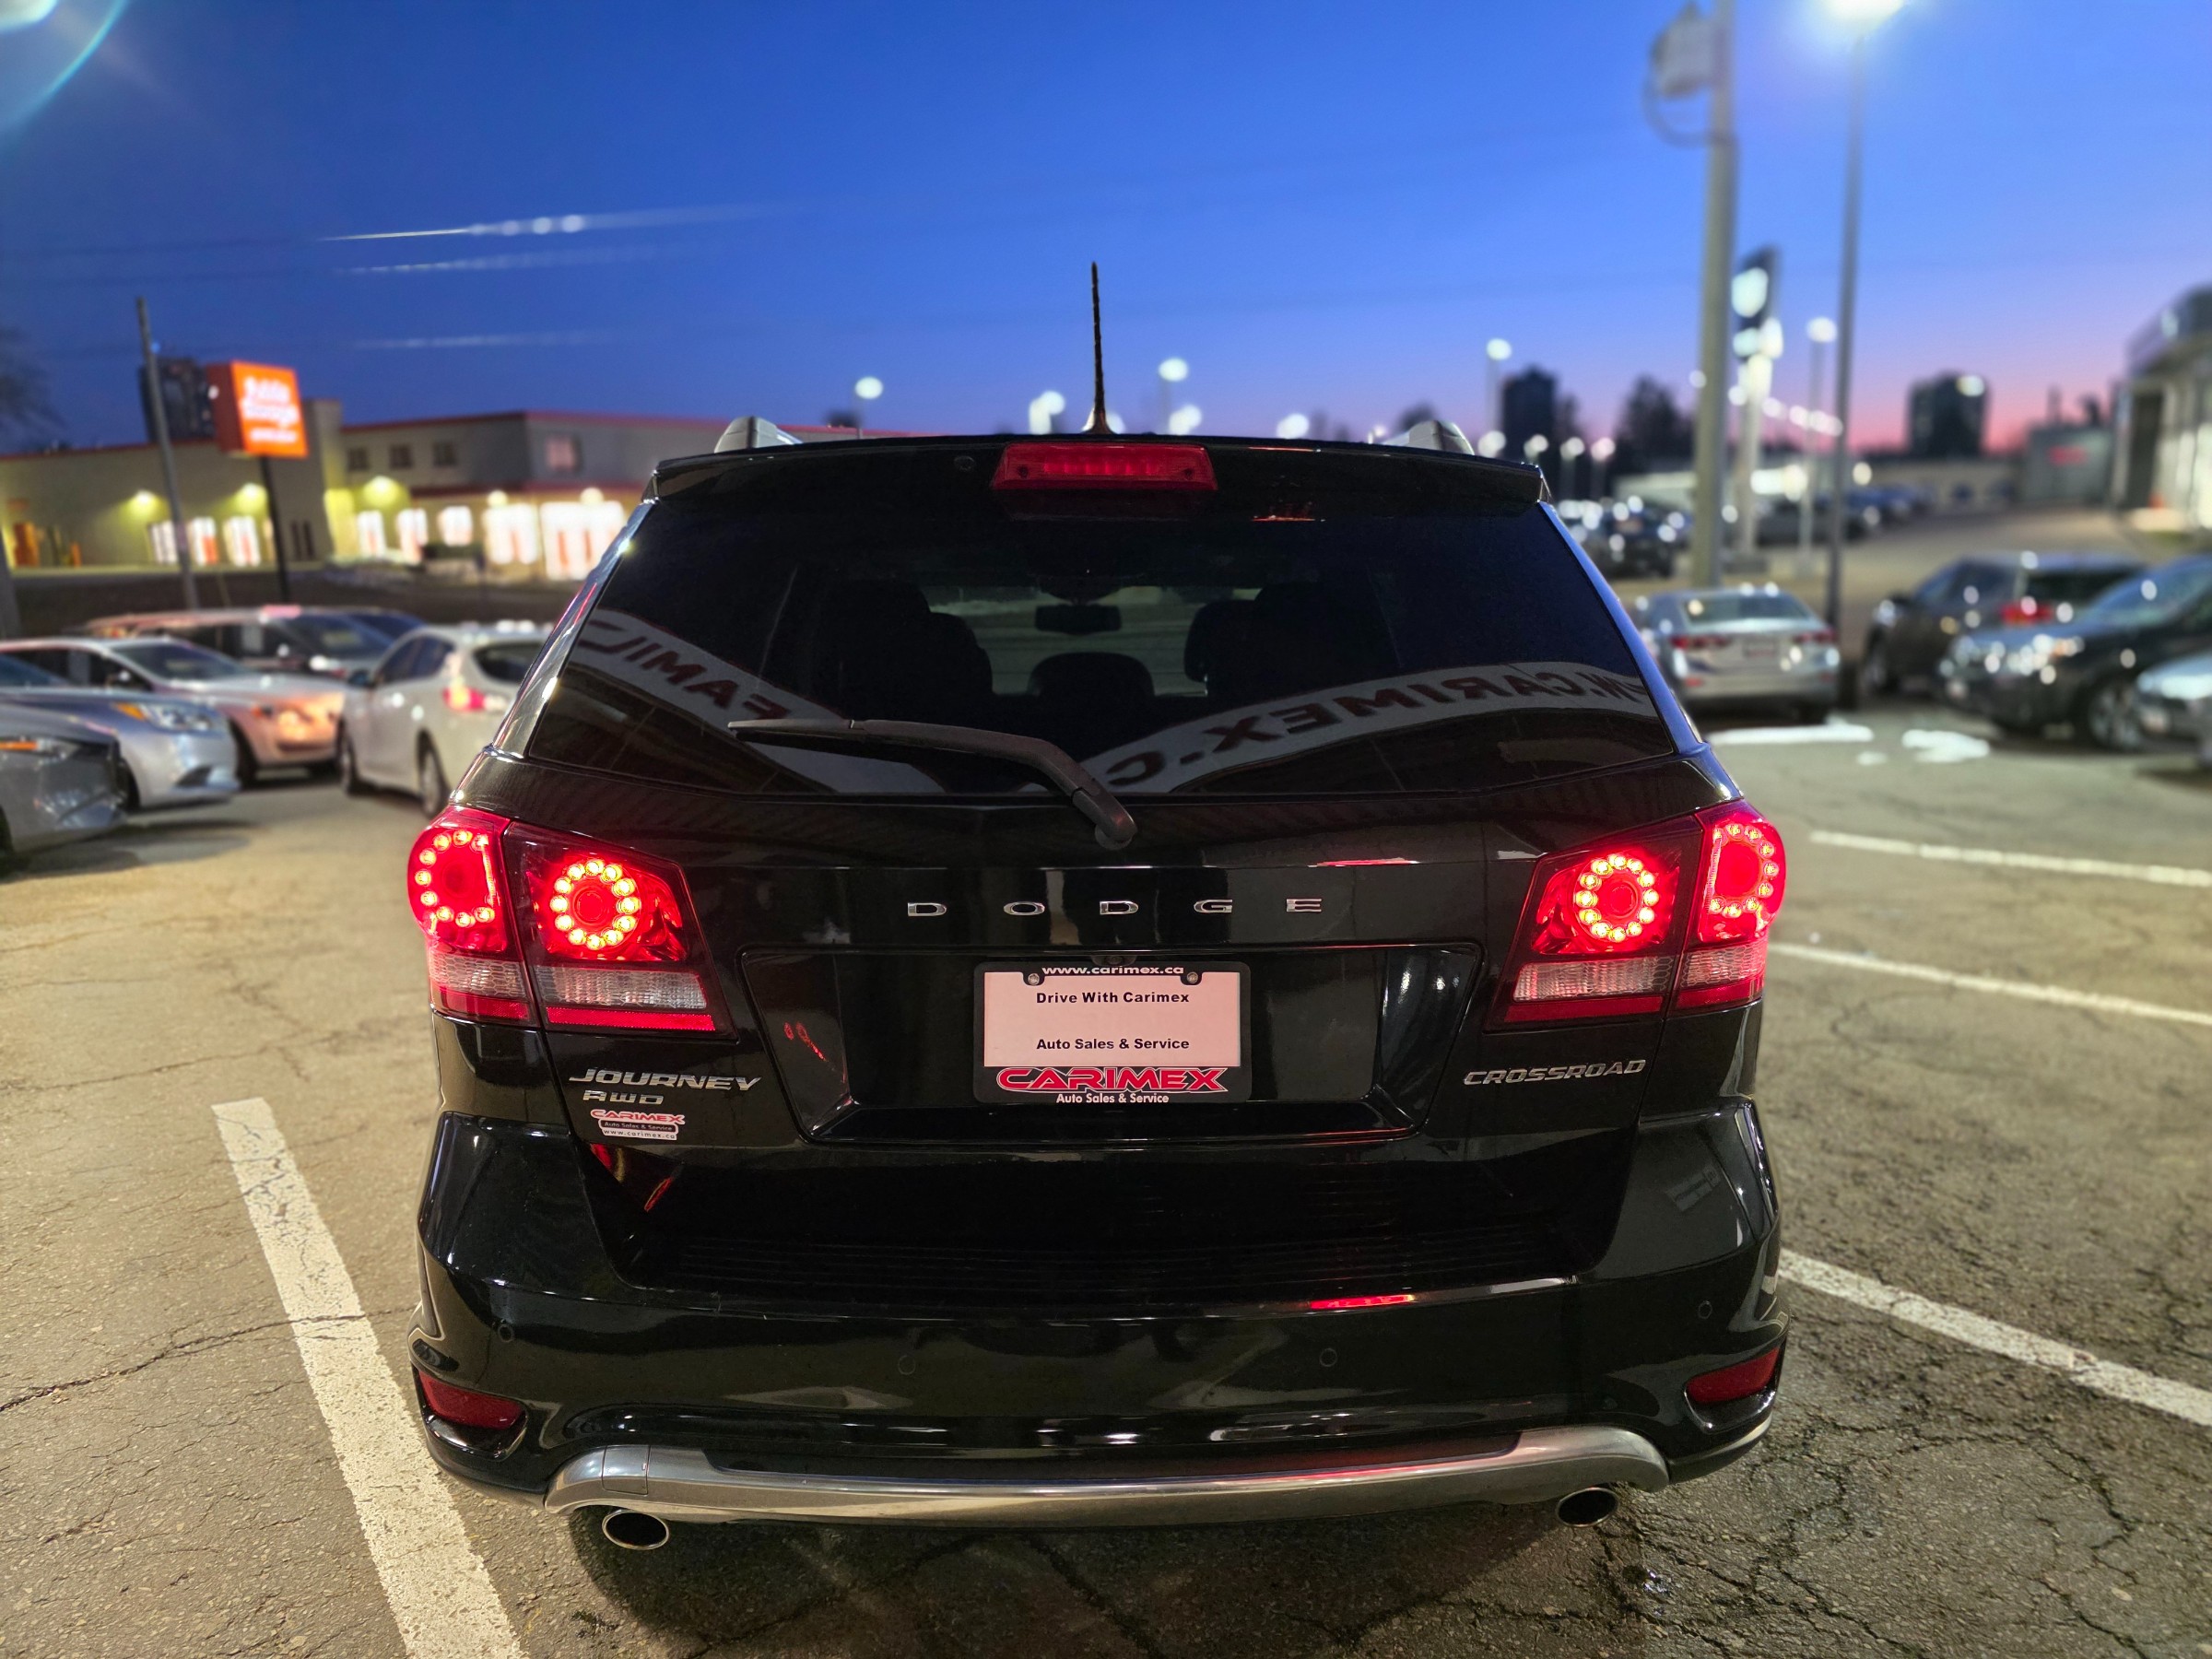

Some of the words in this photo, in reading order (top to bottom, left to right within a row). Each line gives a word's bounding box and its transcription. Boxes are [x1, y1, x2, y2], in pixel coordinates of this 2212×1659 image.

[907, 898, 1323, 917] DODGE
[1041, 965, 1184, 975] www.carimex.ca
[1036, 992, 1077, 1004] Drive
[1082, 992, 1118, 1004] With
[1123, 992, 1190, 1003] Carimex
[1036, 1039, 1071, 1050] Auto
[1075, 1039, 1114, 1049] Sales
[1119, 1039, 1130, 1049] &
[1134, 1038, 1190, 1049] Service
[1464, 1059, 1646, 1086] CROSSROAD
[569, 1067, 762, 1092] JOURNEY
[996, 1067, 1229, 1092] CARIMEX
[582, 1089, 665, 1105] AWD
[1056, 1093, 1083, 1103] Auto
[1086, 1093, 1115, 1103] Sales
[1118, 1094, 1126, 1103] &
[1130, 1093, 1170, 1103] Service
[591, 1110, 685, 1124] CARIMEX
[604, 1129, 676, 1139] www.carimex.ca
[648, 1124, 673, 1132] Service
